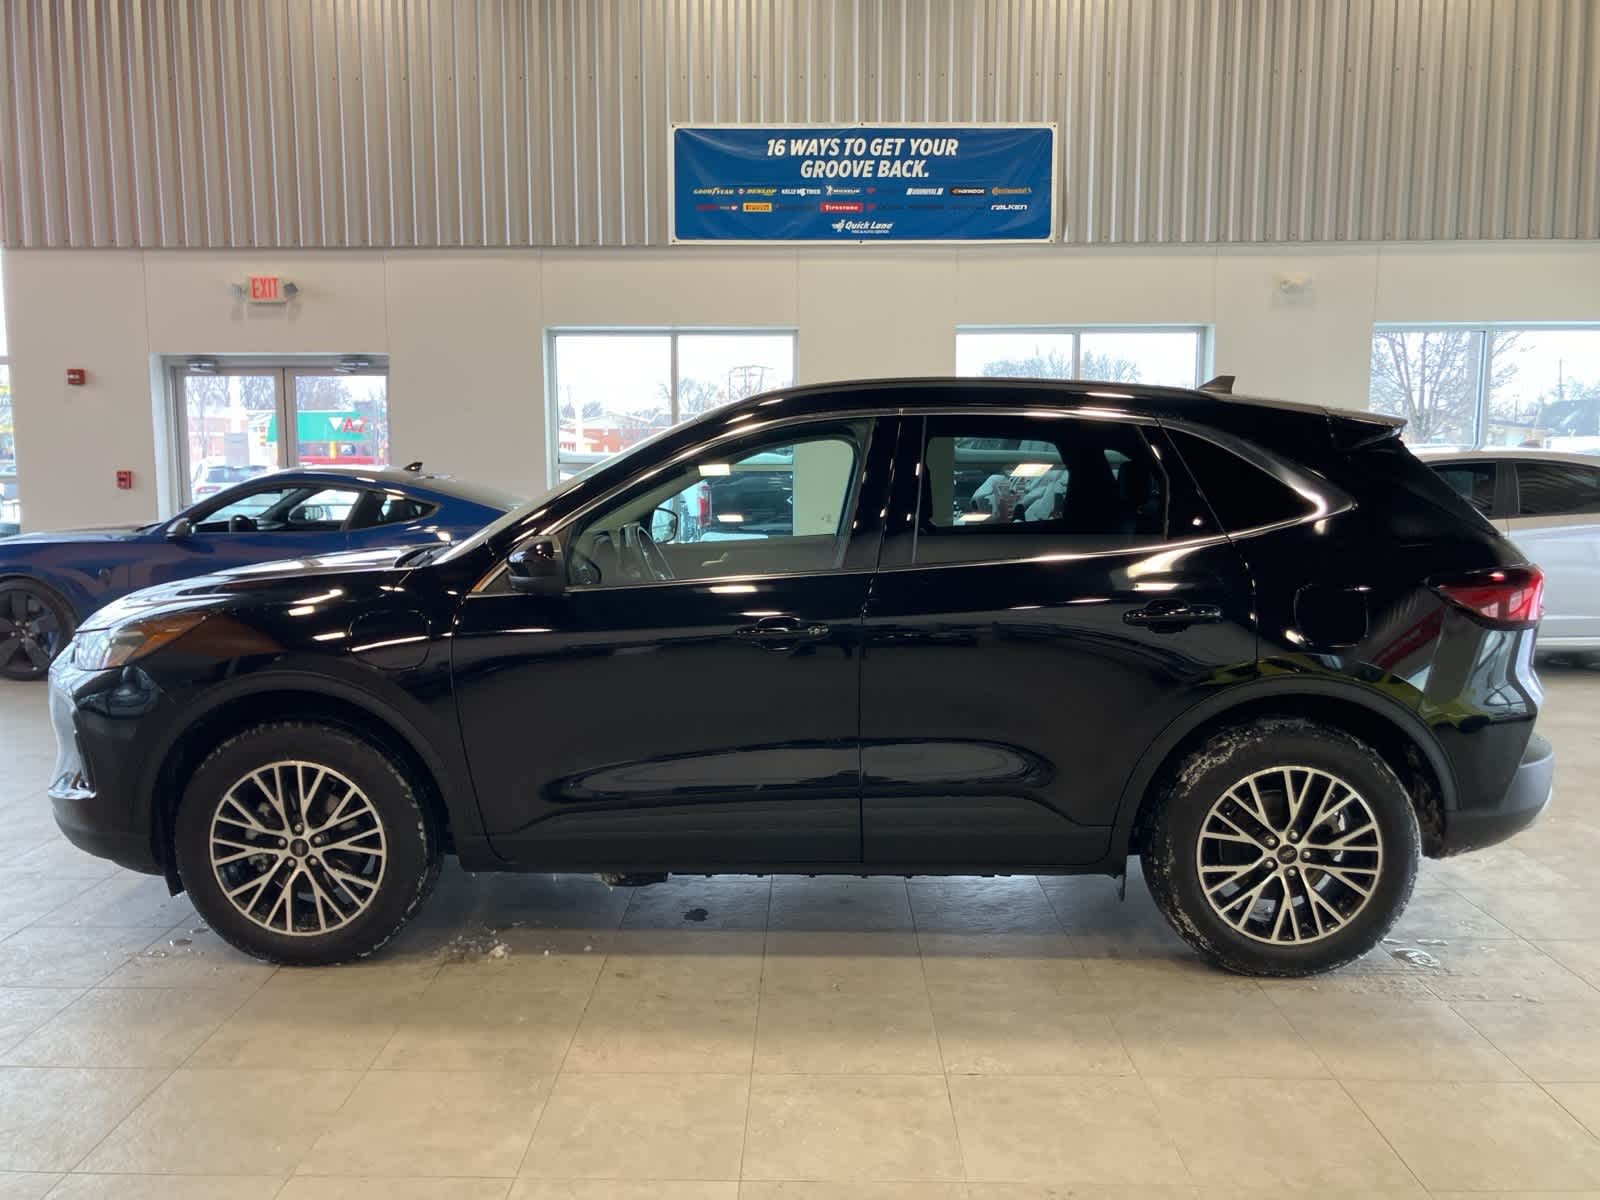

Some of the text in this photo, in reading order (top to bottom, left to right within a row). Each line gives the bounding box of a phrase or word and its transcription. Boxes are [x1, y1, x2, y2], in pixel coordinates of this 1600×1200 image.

[767, 138, 958, 156] 16 WAYS TO GET YOUR
[800, 160, 930, 178] GROOVE BACK.
[845, 221, 894, 231] Quick Lane
[251, 277, 279, 299] EXIT
